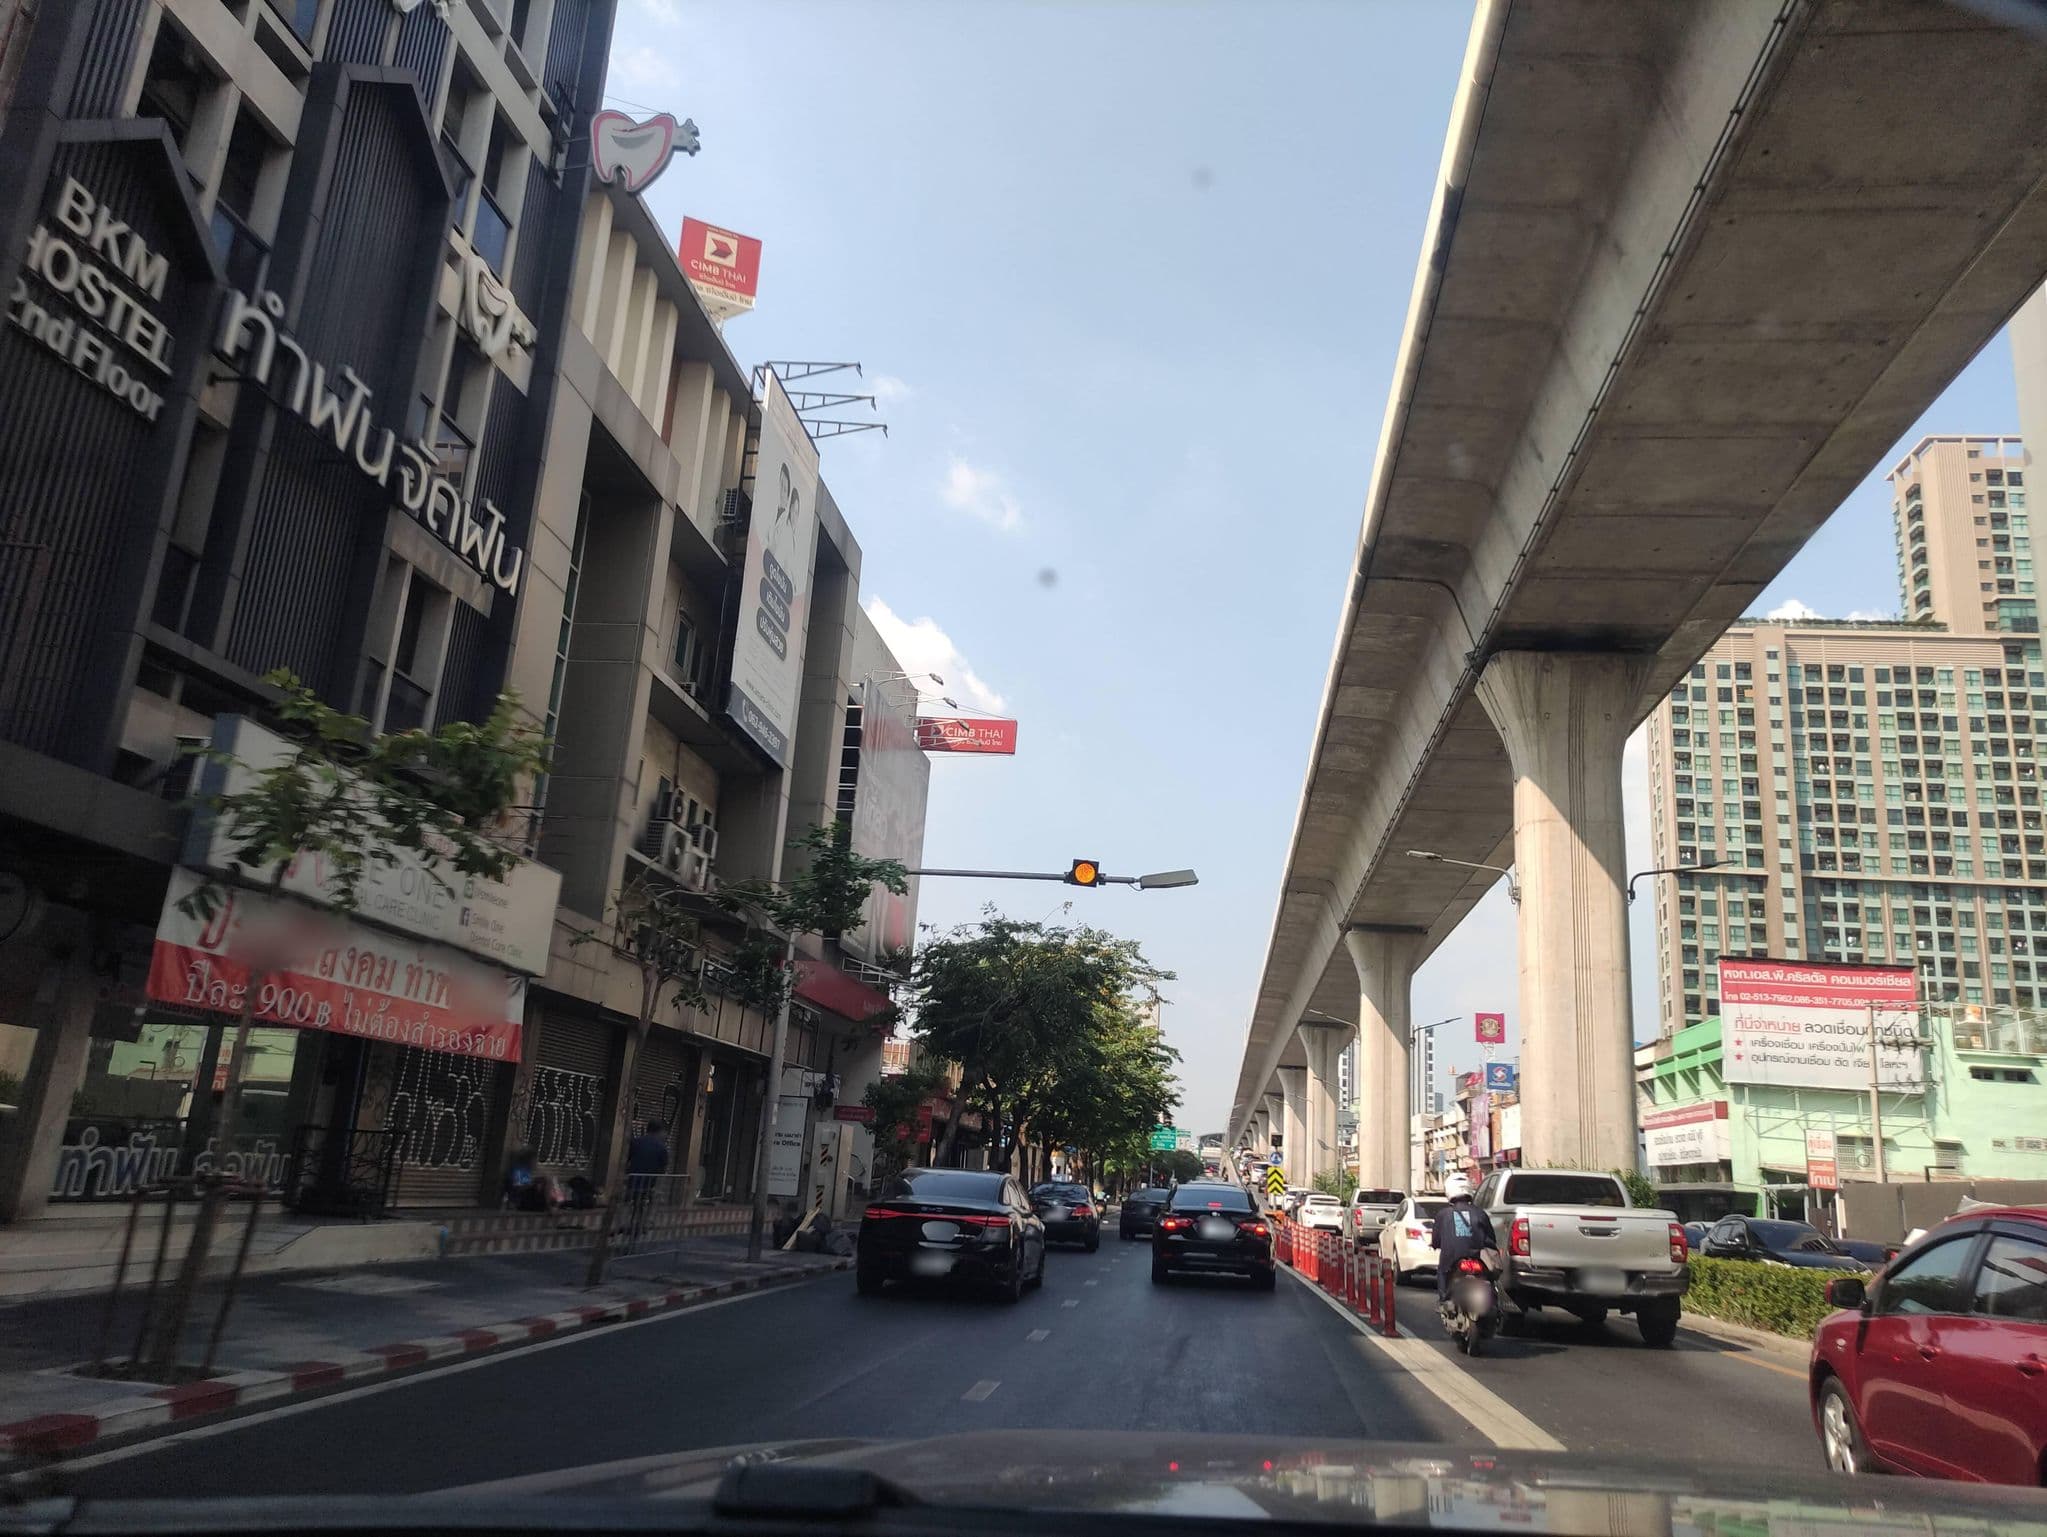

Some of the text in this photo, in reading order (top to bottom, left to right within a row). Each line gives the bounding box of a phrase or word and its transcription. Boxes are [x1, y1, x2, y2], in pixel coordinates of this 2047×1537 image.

[57, 175, 169, 302] BKM
[690, 258, 746, 284] CIMB THAI
[72, 328, 165, 421] Floor
[946, 726, 1004, 739] CIMB THAI
[184, 959, 247, 1009] ปีละ
[344, 988, 507, 1058] ไม่ต้องสำรองจ่าย
